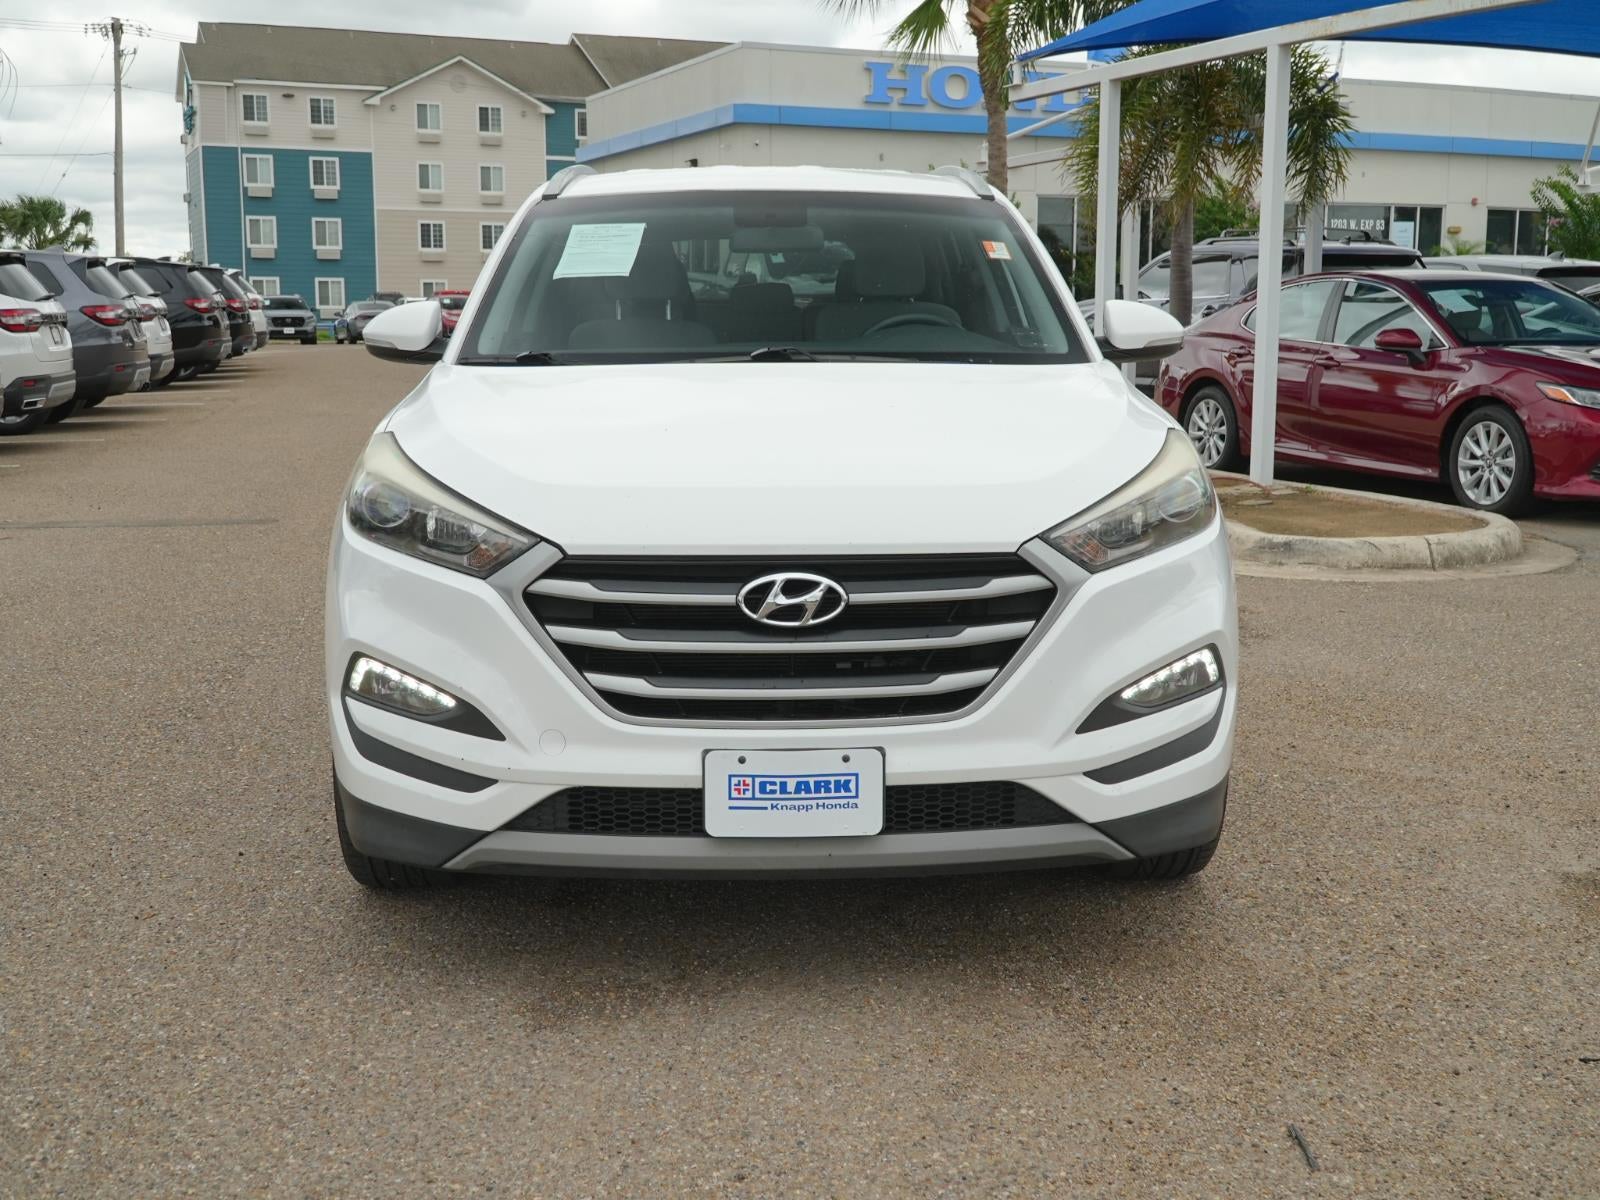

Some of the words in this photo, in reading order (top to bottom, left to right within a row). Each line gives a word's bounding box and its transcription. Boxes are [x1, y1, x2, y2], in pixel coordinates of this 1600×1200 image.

[1331, 218, 1347, 229] 1203
[1350, 219, 1358, 230] W.
[1360, 219, 1374, 230] EXP
[1375, 219, 1385, 230] 83
[758, 779, 852, 796] CLARK
[770, 802, 813, 812] Knapp
[815, 801, 859, 810] Honda
